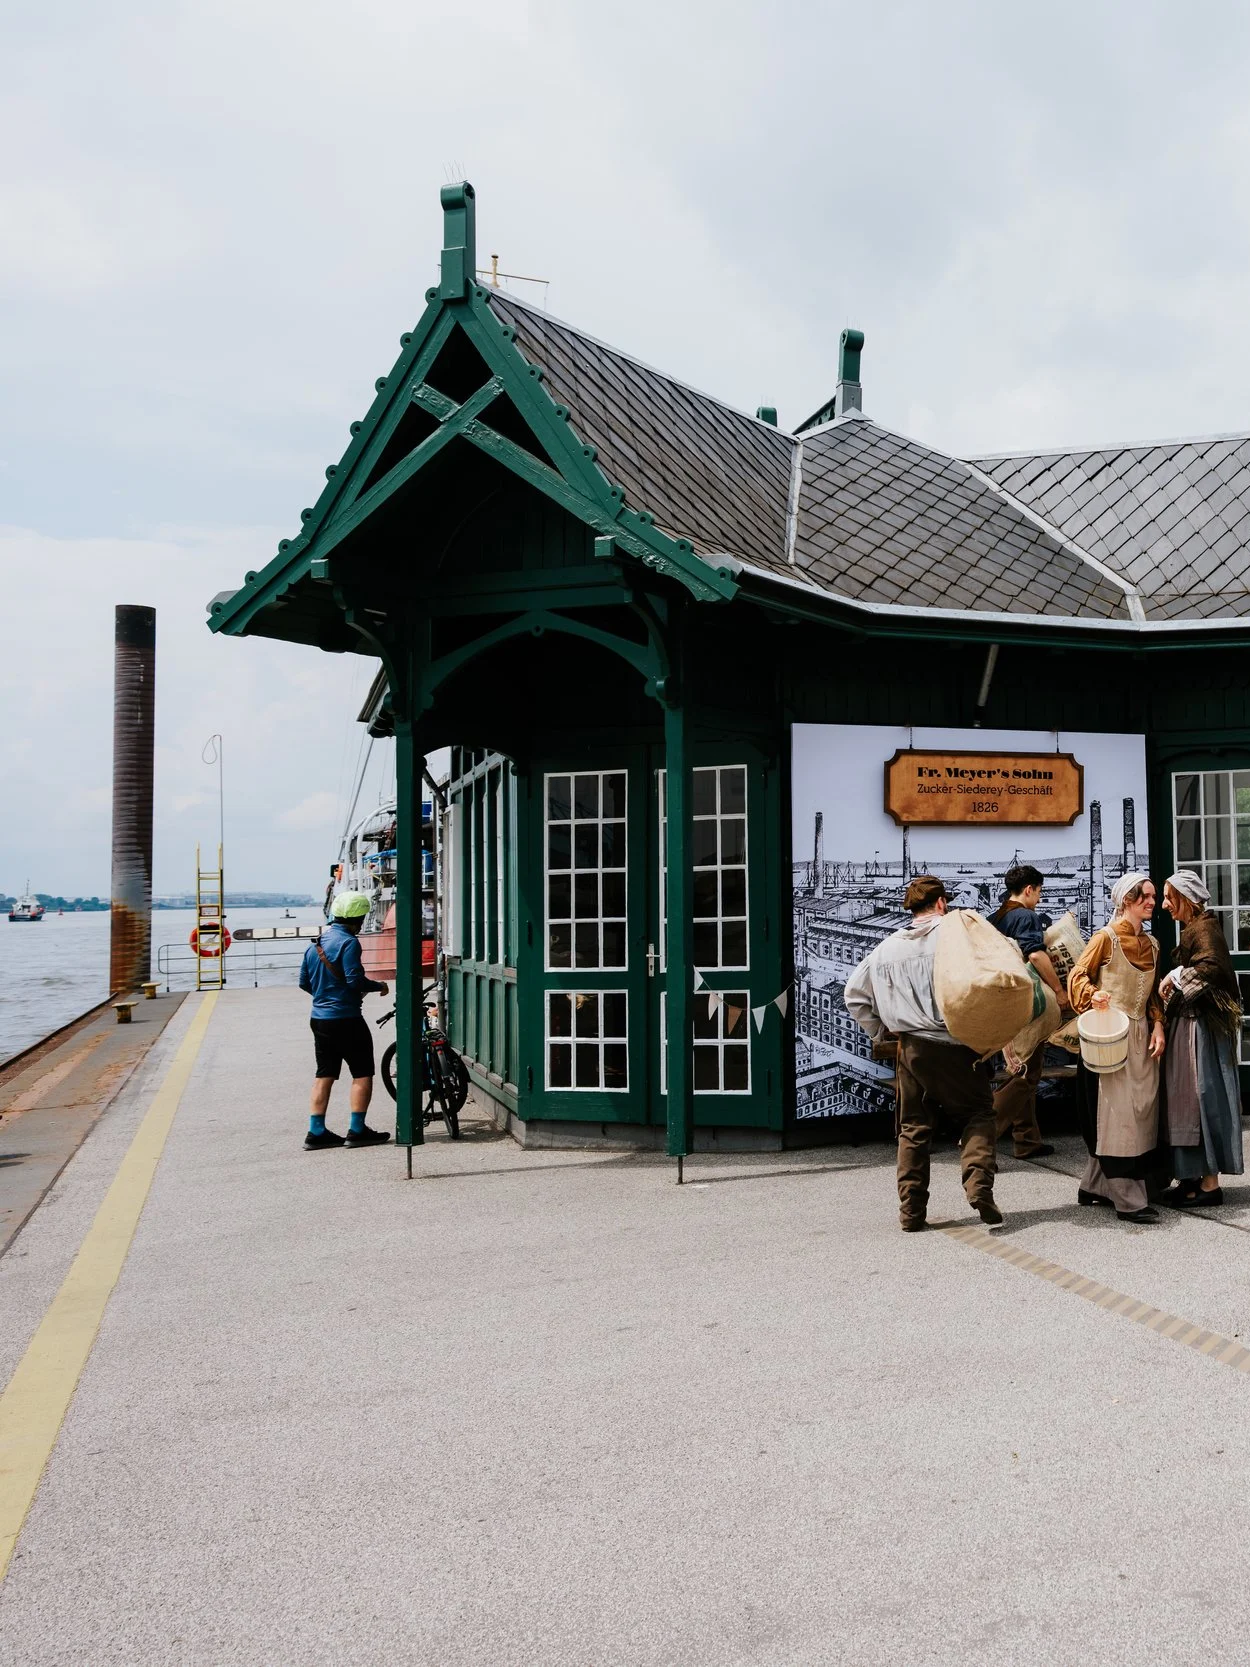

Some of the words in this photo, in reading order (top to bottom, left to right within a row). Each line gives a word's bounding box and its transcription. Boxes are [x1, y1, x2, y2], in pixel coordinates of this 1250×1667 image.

[917, 767, 941, 778] Fr.
[945, 767, 1009, 781] Meyer's
[1012, 769, 1053, 780] Sohn
[917, 784, 1053, 796] Zucker-Siederey-Geschäft
[972, 802, 999, 813] 1826
